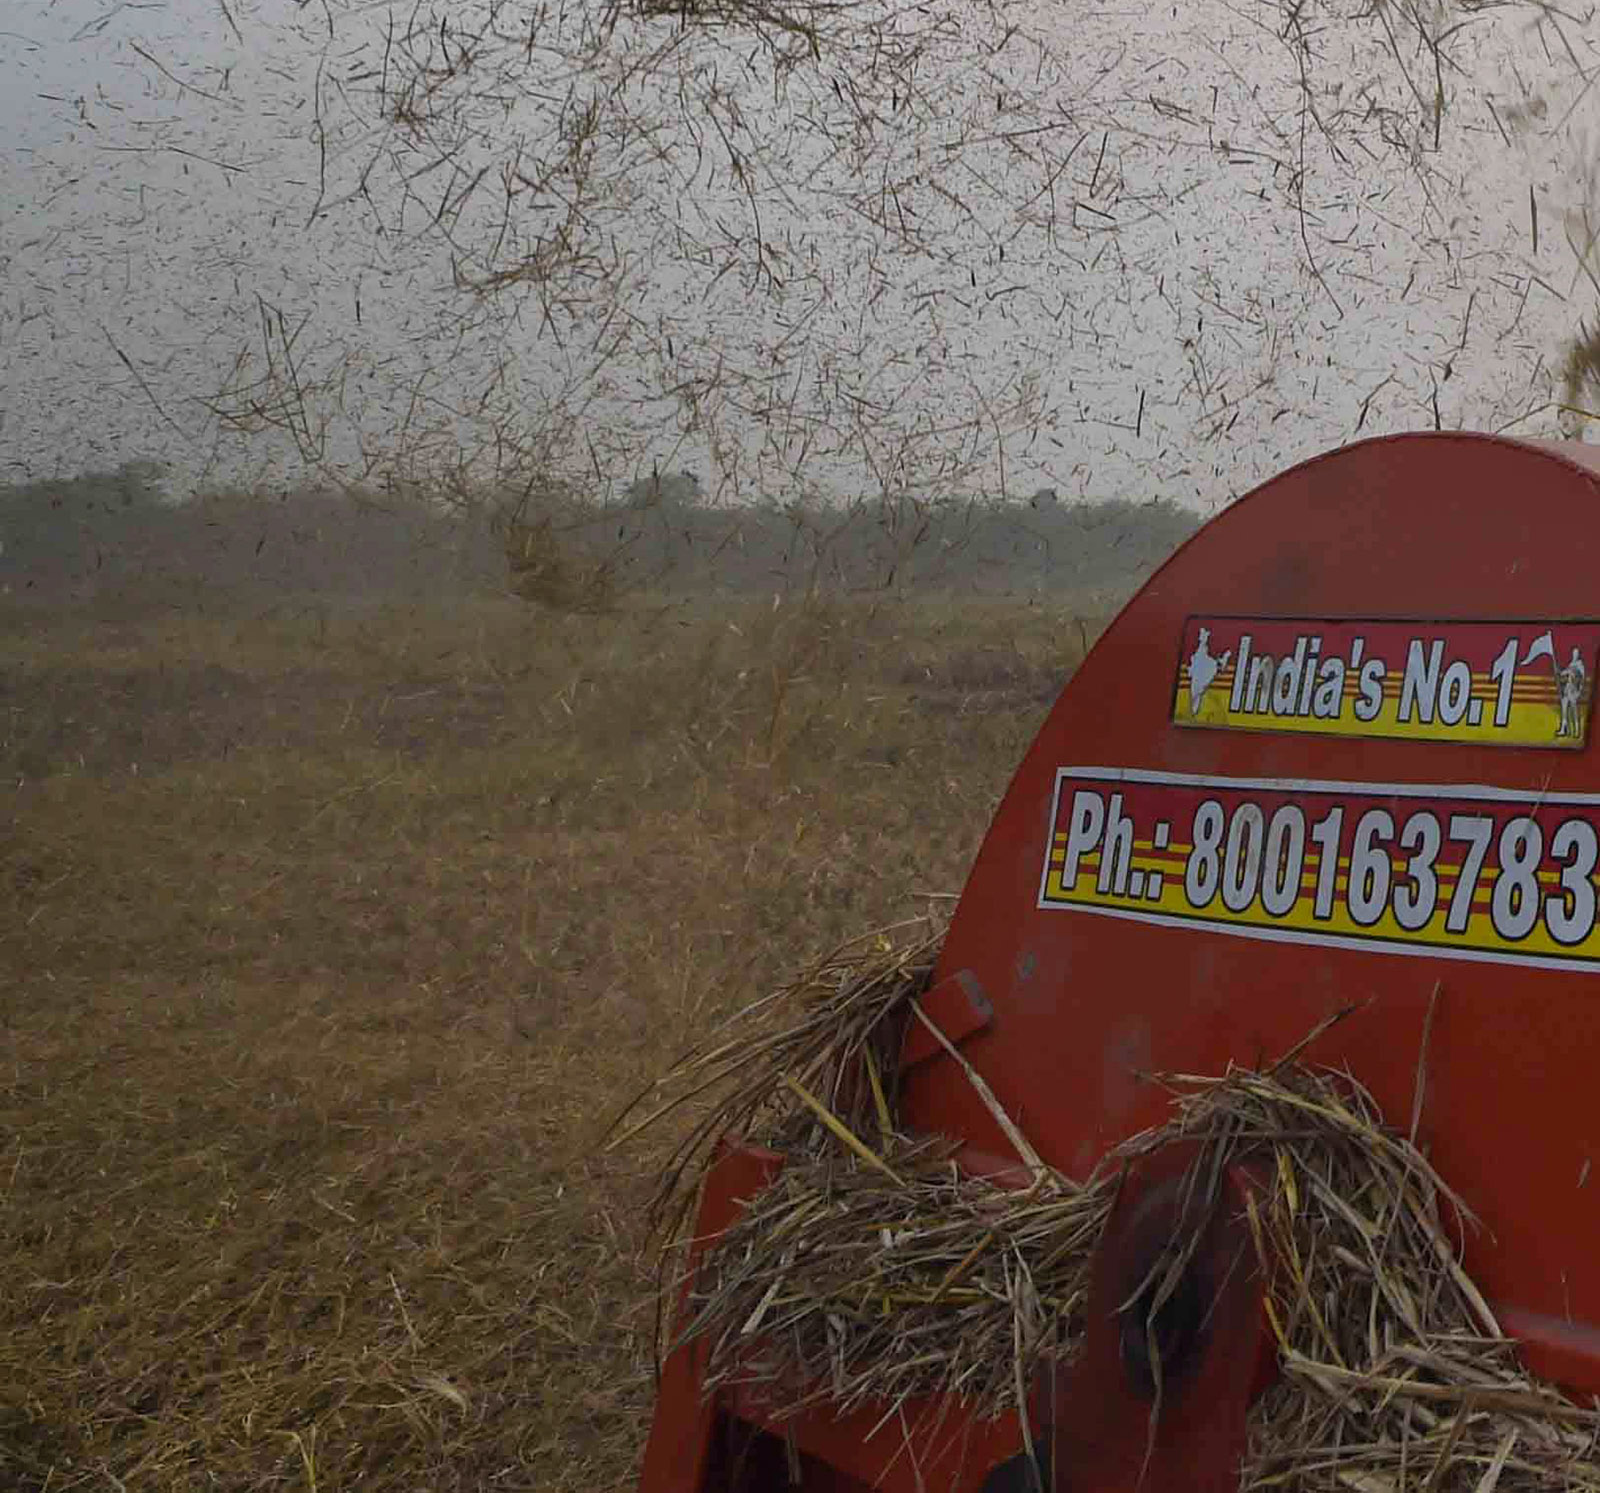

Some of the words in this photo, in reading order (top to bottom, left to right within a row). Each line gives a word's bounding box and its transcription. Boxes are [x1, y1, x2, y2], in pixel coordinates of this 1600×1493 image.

[1228, 634, 1386, 722] India's
[1397, 637, 1520, 728] No.1
[1061, 789, 1170, 901] Ph.:
